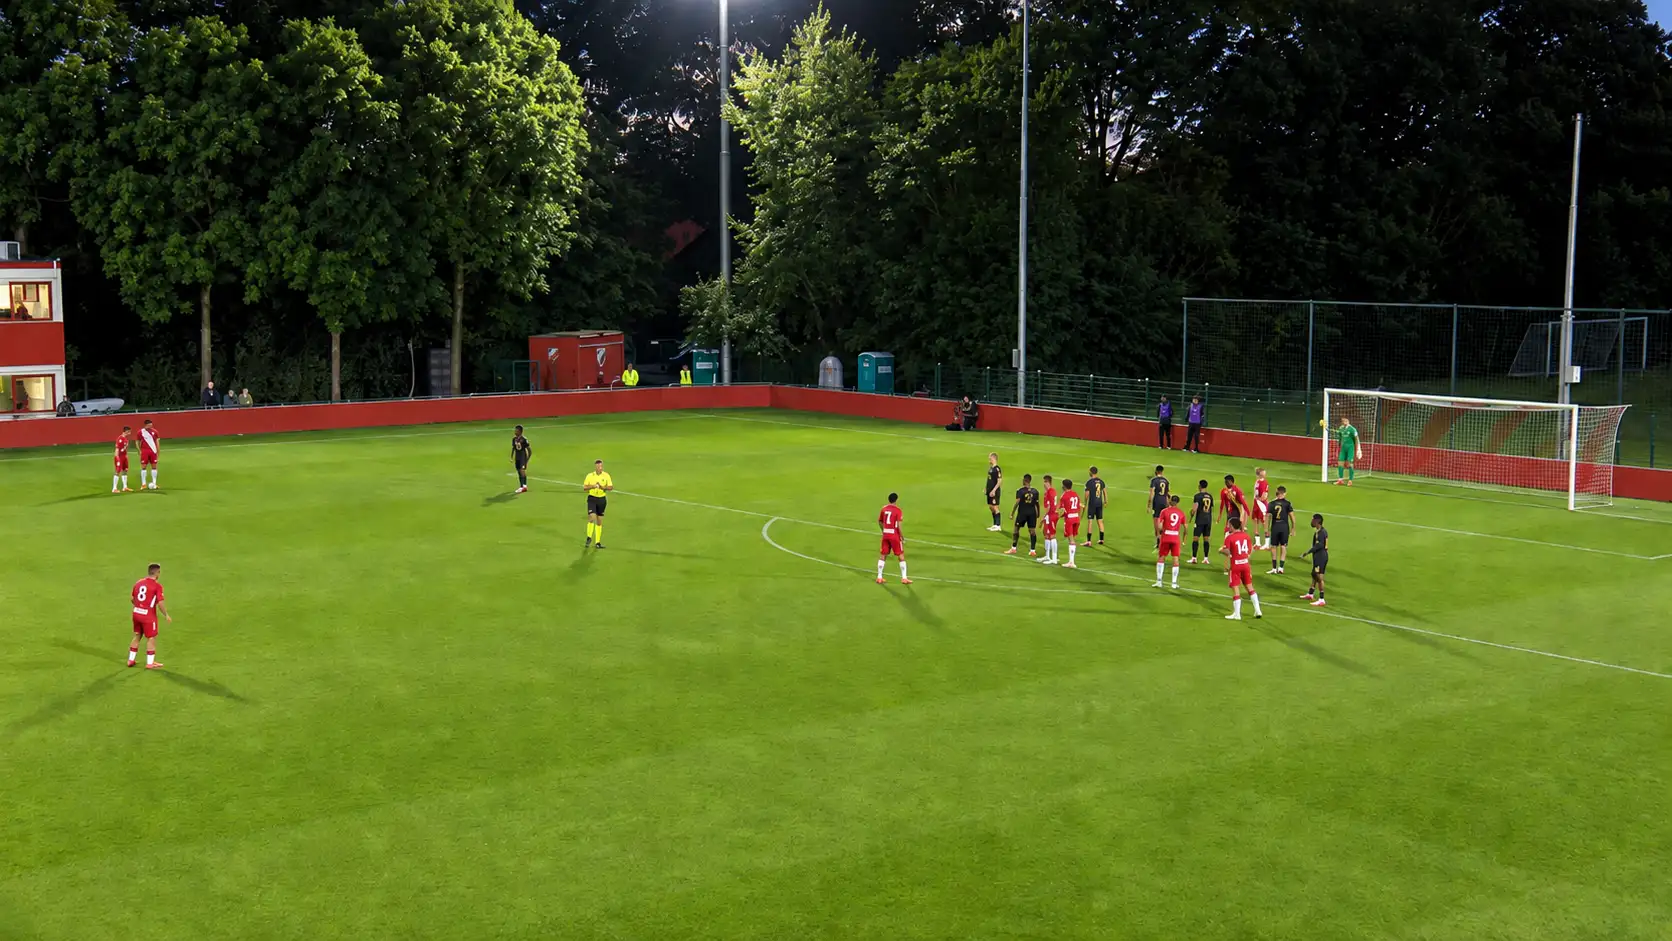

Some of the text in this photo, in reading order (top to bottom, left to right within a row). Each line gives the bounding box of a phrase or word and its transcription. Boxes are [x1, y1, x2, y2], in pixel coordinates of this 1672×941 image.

[884, 511, 892, 524] 7
[1170, 513, 1179, 527] 9
[1235, 539, 1249, 555] 14
[137, 585, 147, 601] 8
